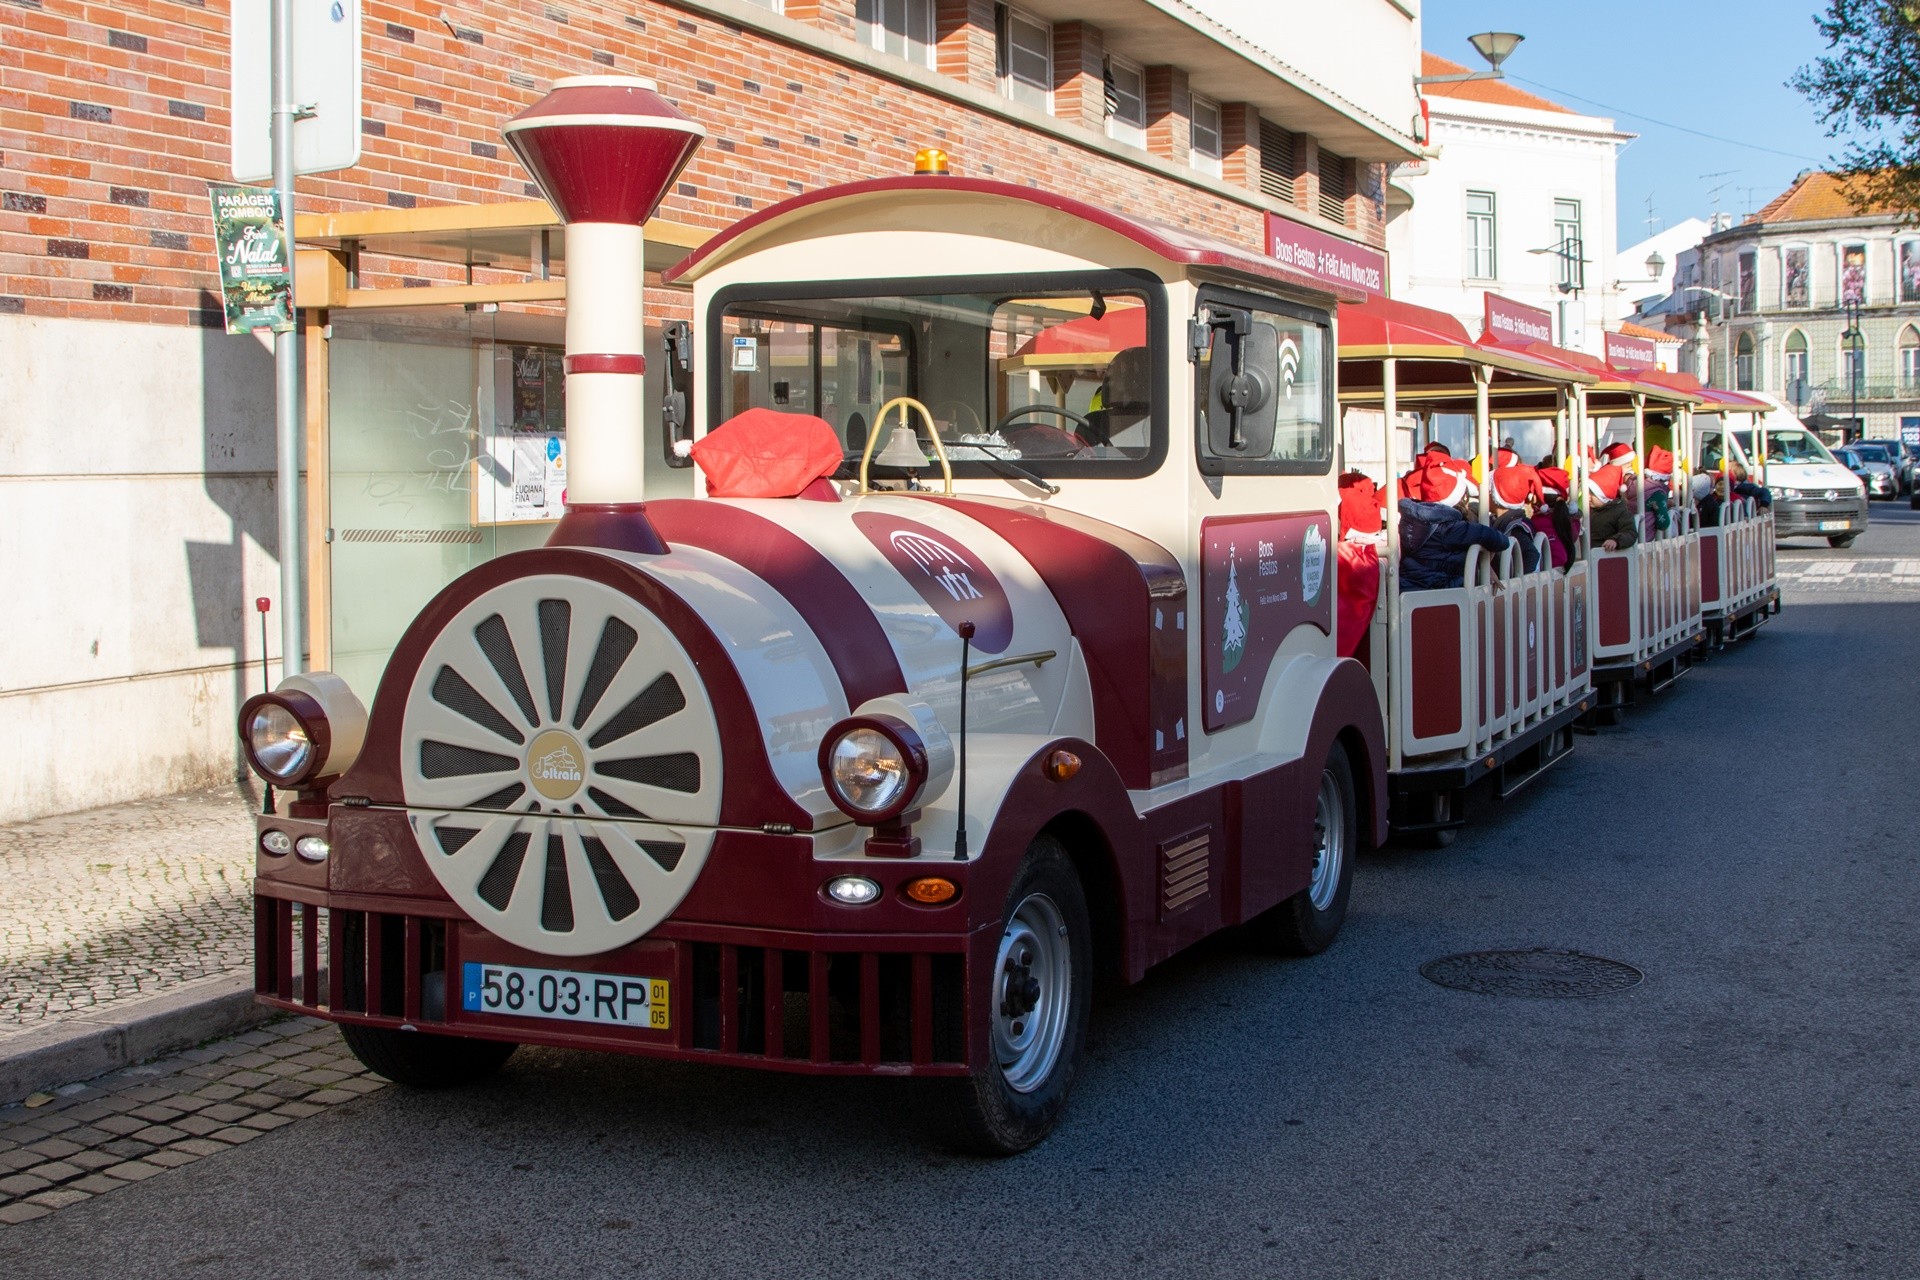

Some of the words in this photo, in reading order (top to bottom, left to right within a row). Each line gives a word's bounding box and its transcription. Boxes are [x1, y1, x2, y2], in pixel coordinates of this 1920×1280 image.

[218, 195, 275, 207] PARAGEM
[221, 207, 275, 219] COMBOIO
[243, 226, 268, 241] Feira
[226, 239, 280, 264] Natal
[1275, 237, 1293, 263] Boas
[1294, 243, 1316, 270] Festas
[1325, 252, 1339, 277] Feliz
[1340, 258, 1351, 281] Ano
[1351, 262, 1366, 286] Novo
[1366, 266, 1380, 290] 2025
[1540, 325, 1549, 341] 2025
[515, 484, 543, 494] LUCIANA
[515, 493, 530, 502] FINA
[1258, 540, 1274, 558] Boas
[1258, 559, 1278, 577] Festas
[469, 991, 476, 1002] P
[653, 985, 665, 999] 01
[651, 1010, 666, 1025] 05
